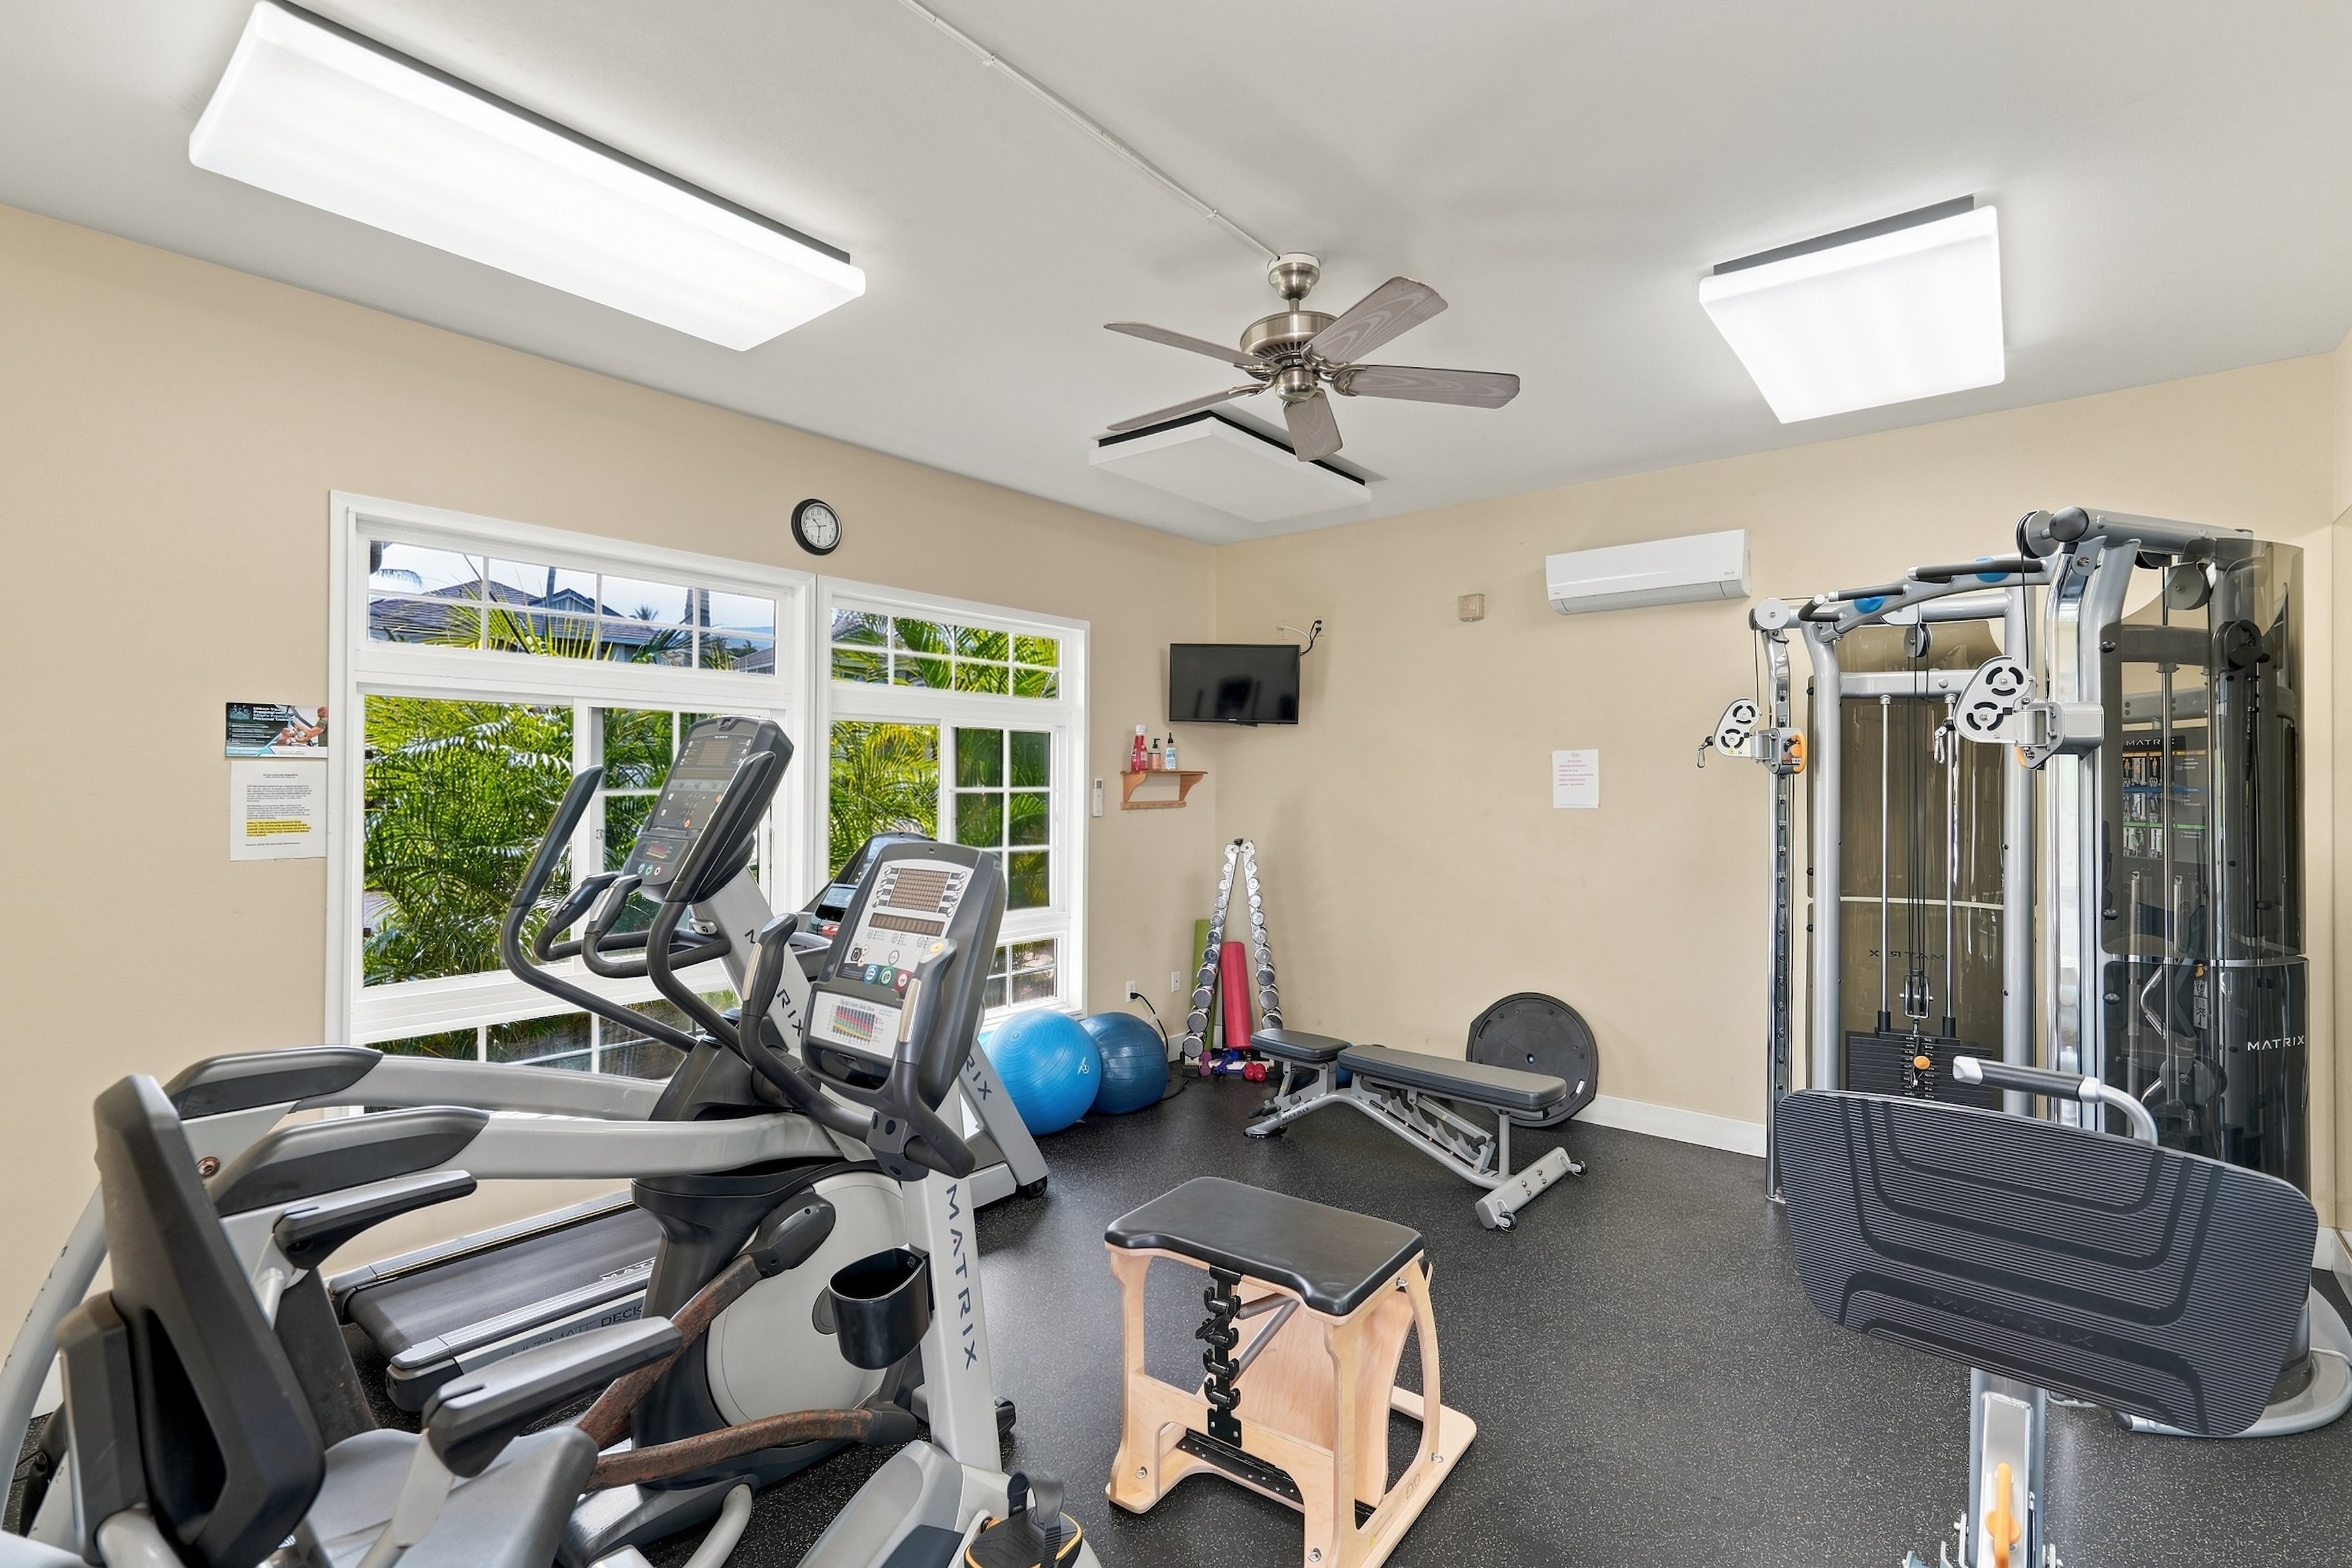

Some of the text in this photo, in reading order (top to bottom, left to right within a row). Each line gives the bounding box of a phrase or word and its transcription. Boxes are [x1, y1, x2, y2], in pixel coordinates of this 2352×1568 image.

[2247, 1035, 2304, 1051] MATRIX
[1282, 1107, 1311, 1122] MATRIX
[946, 1184, 977, 1371] MATRIX
